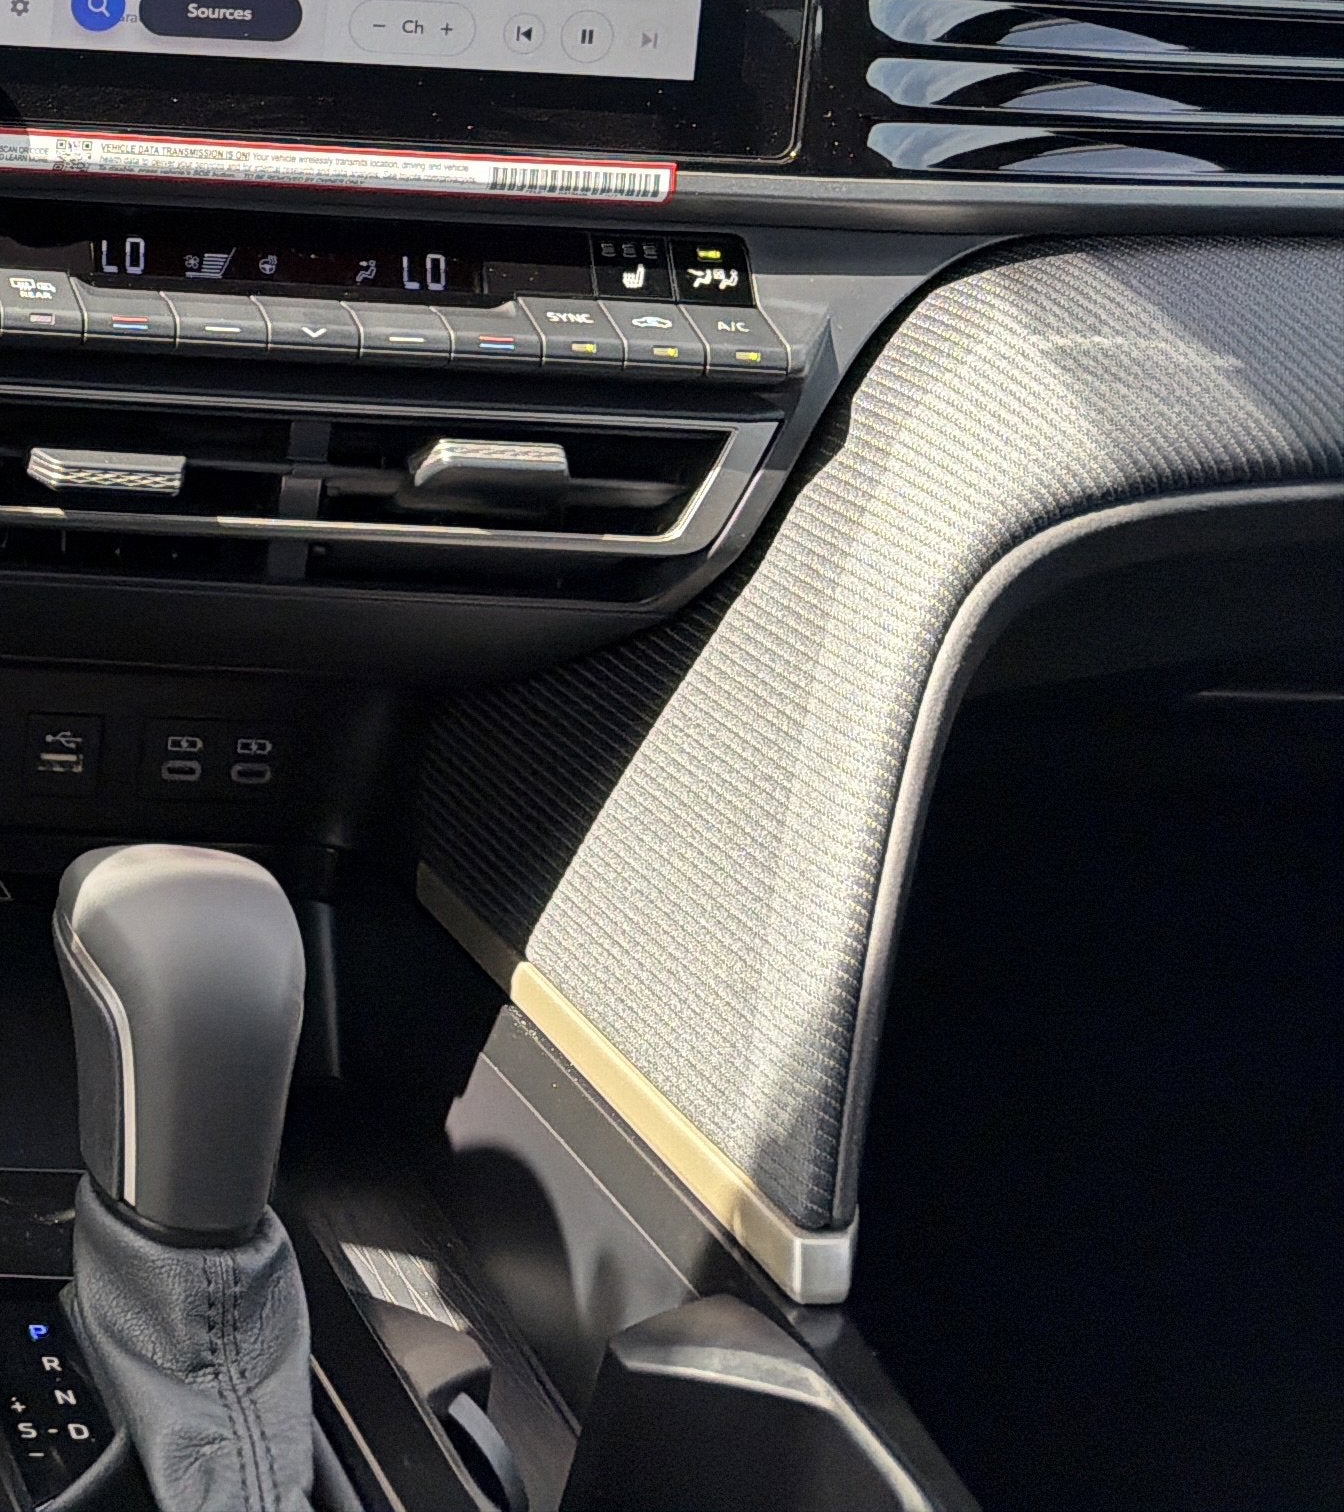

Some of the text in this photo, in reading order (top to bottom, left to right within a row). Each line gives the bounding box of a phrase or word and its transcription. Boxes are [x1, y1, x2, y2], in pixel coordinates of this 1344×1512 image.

[186, 2, 253, 21] Sources
[401, 19, 424, 36] Ch
[100, 143, 137, 153] VEHICLE
[138, 145, 160, 155] DATA
[161, 146, 224, 159] TRANSMISSION
[546, 311, 595, 325] SYNC
[717, 320, 748, 334] A/C
[28, 1324, 50, 1341] P
[41, 1355, 62, 1372] R
[54, 1389, 78, 1406] N
[17, 1422, 90, 1440] S D
